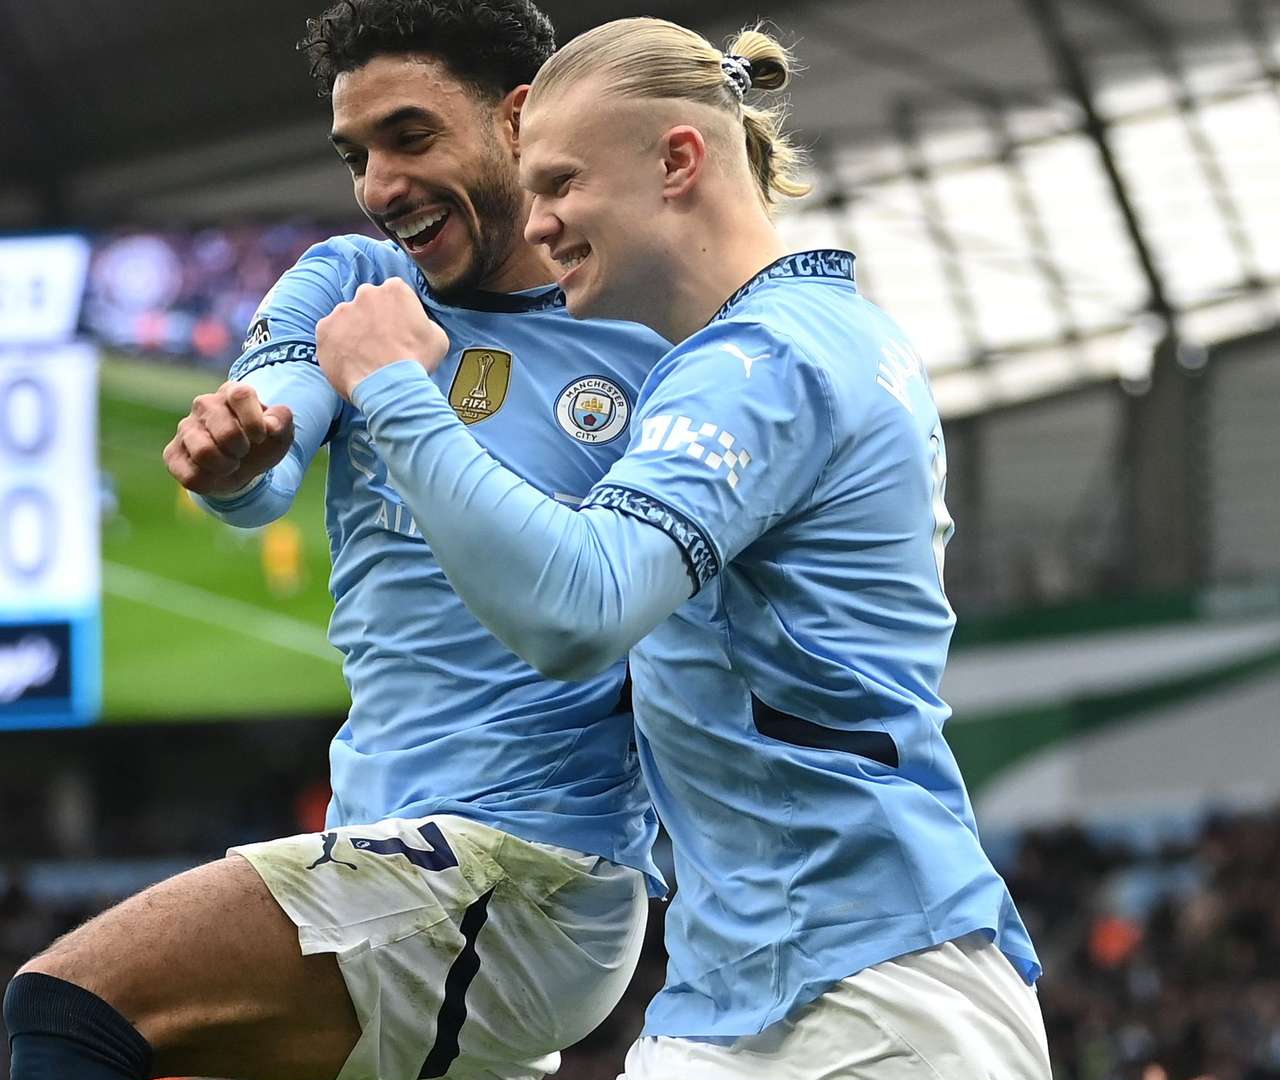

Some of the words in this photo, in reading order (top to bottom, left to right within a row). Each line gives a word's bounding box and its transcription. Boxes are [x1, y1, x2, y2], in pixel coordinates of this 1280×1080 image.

[461, 397, 487, 410] FIFA
[566, 381, 624, 407] MANCHESTER
[575, 431, 598, 441] CITY
[349, 821, 460, 872] 7
